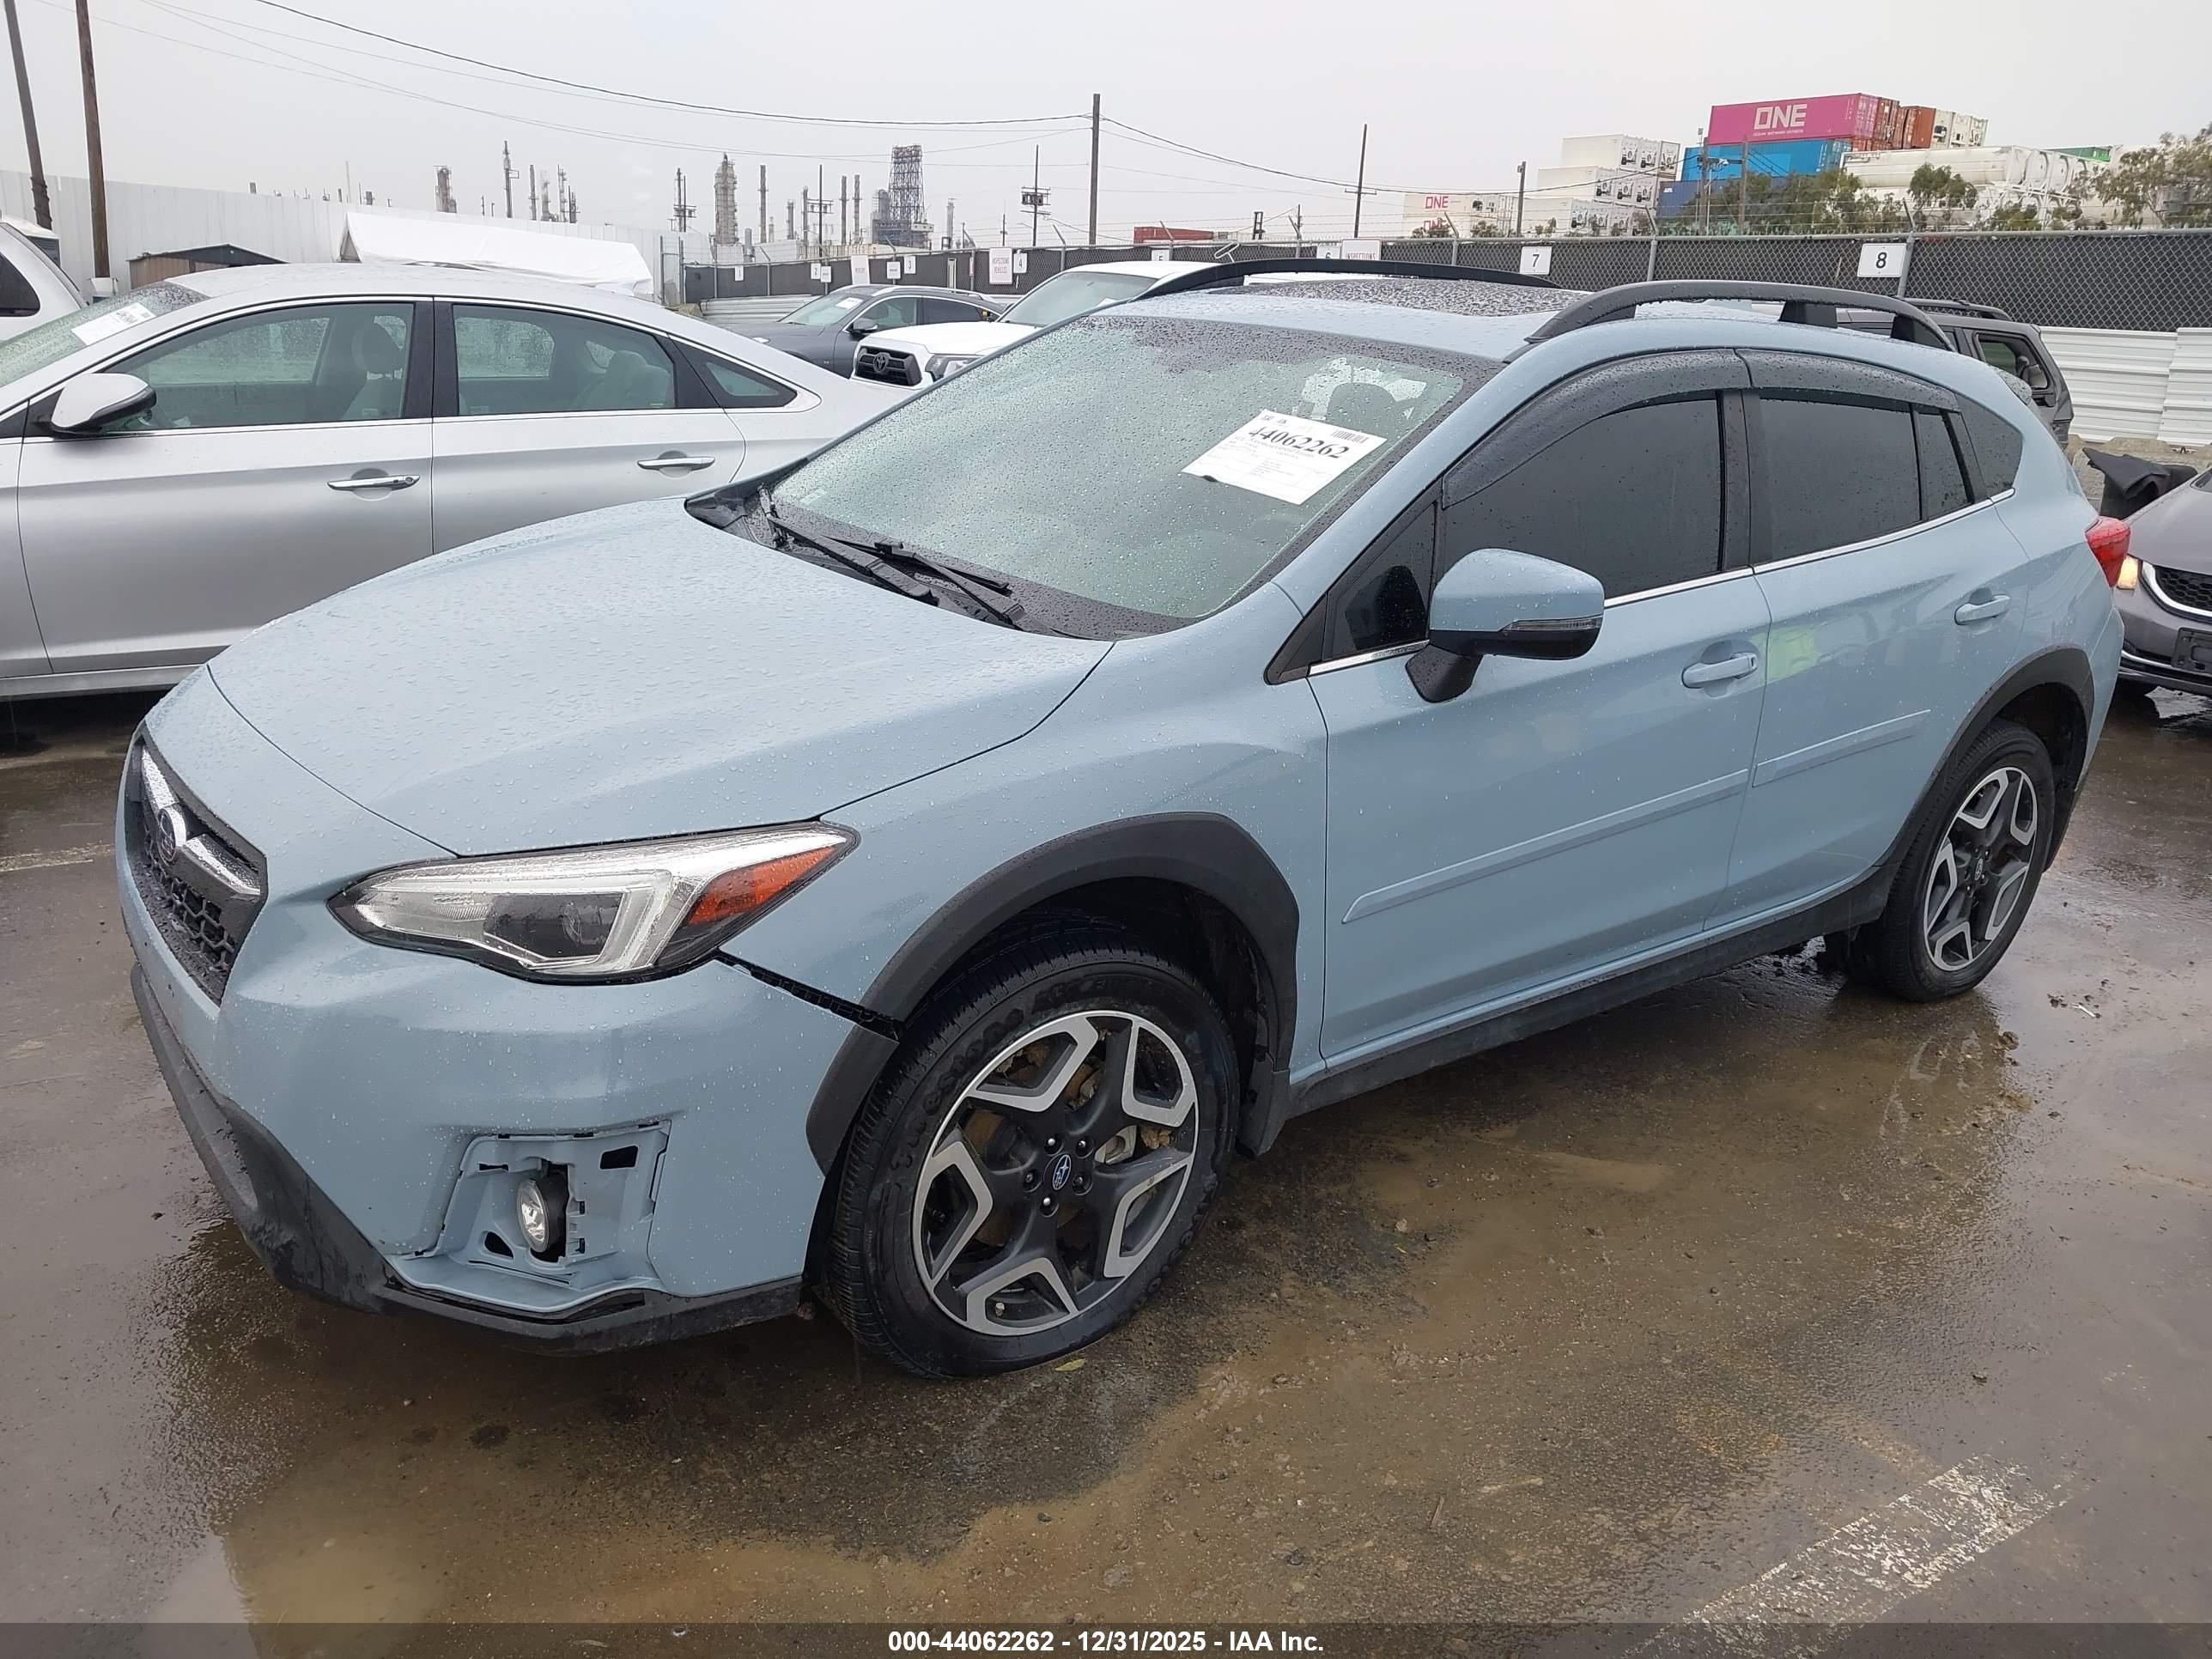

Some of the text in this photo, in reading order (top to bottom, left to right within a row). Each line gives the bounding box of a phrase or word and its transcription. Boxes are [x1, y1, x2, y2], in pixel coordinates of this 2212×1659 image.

[1754, 104, 1807, 130] ONE
[1425, 196, 1449, 209] ONE
[908, 260, 912, 270] 3
[1018, 258, 1023, 268] 4
[1532, 253, 1540, 267] 7
[1875, 252, 1887, 269] 8
